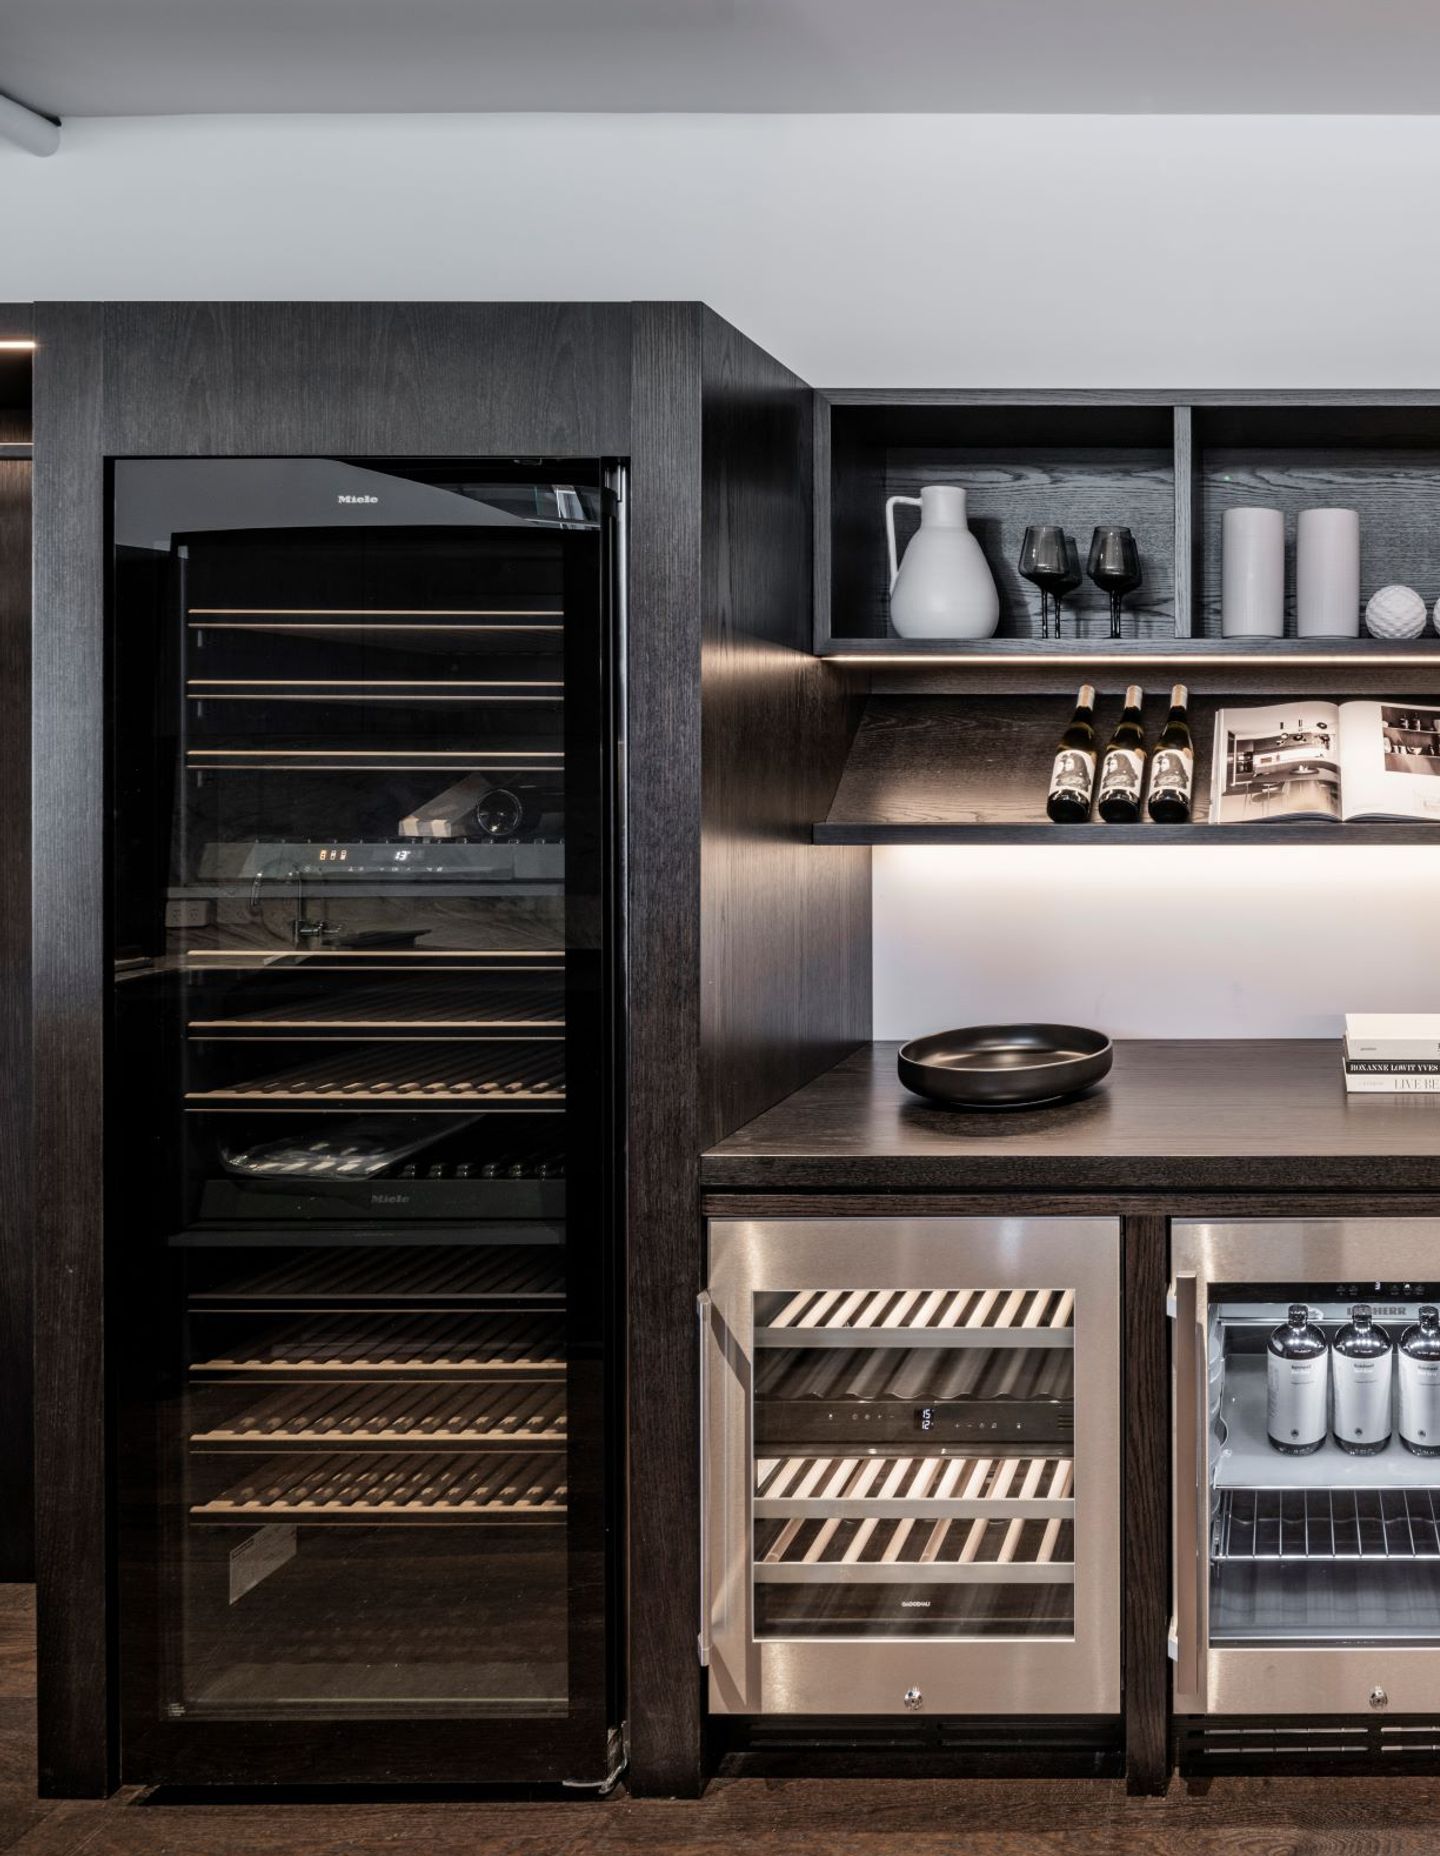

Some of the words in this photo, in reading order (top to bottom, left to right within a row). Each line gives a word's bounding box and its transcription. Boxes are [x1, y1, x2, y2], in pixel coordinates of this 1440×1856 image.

[338, 495, 379, 503] Miele
[1350, 1064, 1389, 1072] ROXANNE
[1390, 1064, 1416, 1072] LOWIT
[1417, 1064, 1438, 1072] YVES
[1394, 1079, 1419, 1090] LIVE
[1346, 1306, 1407, 1316] LHERR
